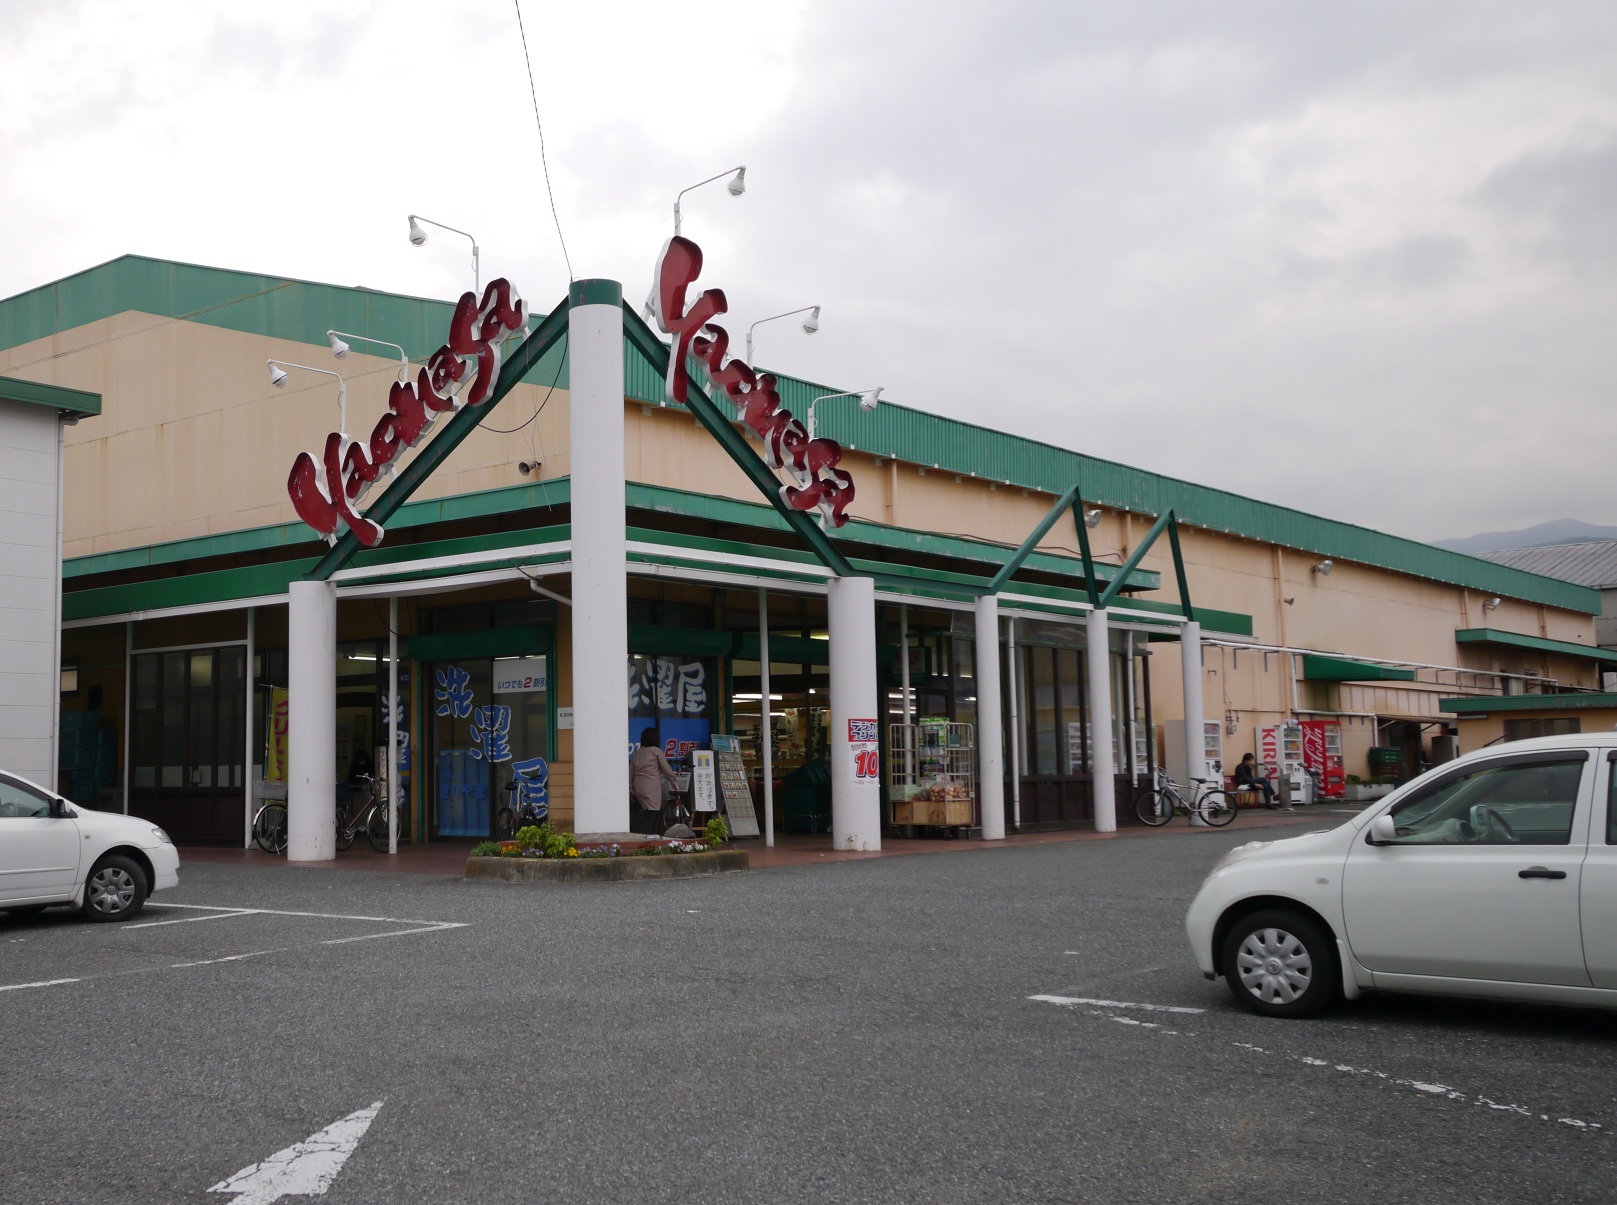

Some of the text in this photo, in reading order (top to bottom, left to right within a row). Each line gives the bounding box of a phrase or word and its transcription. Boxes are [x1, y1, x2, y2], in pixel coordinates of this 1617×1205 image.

[850, 720, 879, 731] デジカ
[850, 731, 879, 741] プリン
[1262, 728, 1278, 781] KIRIN
